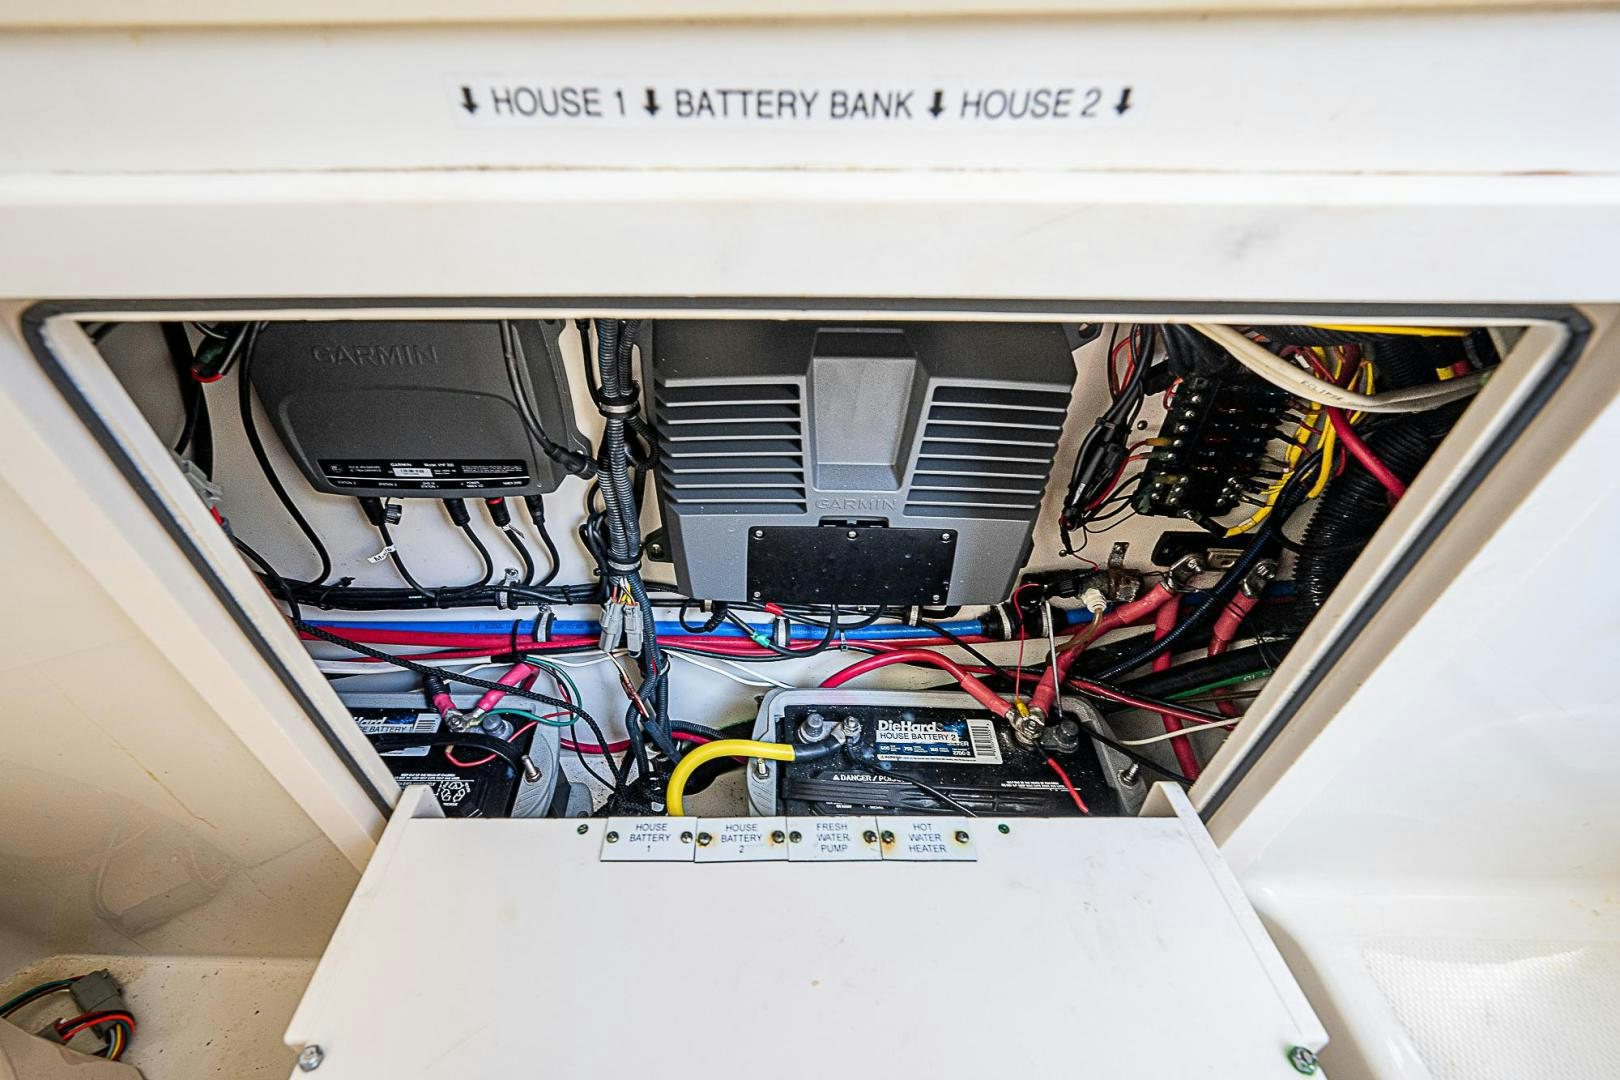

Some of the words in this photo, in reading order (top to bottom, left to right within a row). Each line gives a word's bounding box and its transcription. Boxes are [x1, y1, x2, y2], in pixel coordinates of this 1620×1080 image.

[490, 87, 602, 117] HOUSE
[614, 89, 626, 117] 1
[674, 88, 819, 118] BATTERY
[829, 89, 914, 118] BANK
[960, 88, 1074, 119] HOUSE
[1080, 88, 1102, 118] 2
[312, 344, 440, 366] GARMIN
[814, 498, 898, 512] GARMIN
[368, 725, 408, 733] BATTERY
[878, 719, 938, 732] DieHard
[880, 732, 910, 740] HOUSE
[911, 733, 949, 741] BATTERY
[840, 774, 871, 782] DANGER
[635, 823, 668, 832] HOUSE
[725, 823, 758, 832] HOUSE
[816, 823, 849, 831] FRESH
[912, 823, 932, 831] HOT
[628, 833, 672, 842] BATTERY
[720, 834, 762, 843] BATTERY
[816, 833, 851, 842] WATER
[908, 833, 943, 842] WATER
[738, 845, 745, 853] 2
[820, 844, 849, 853] PUMP
[908, 844, 948, 853] HEATER
